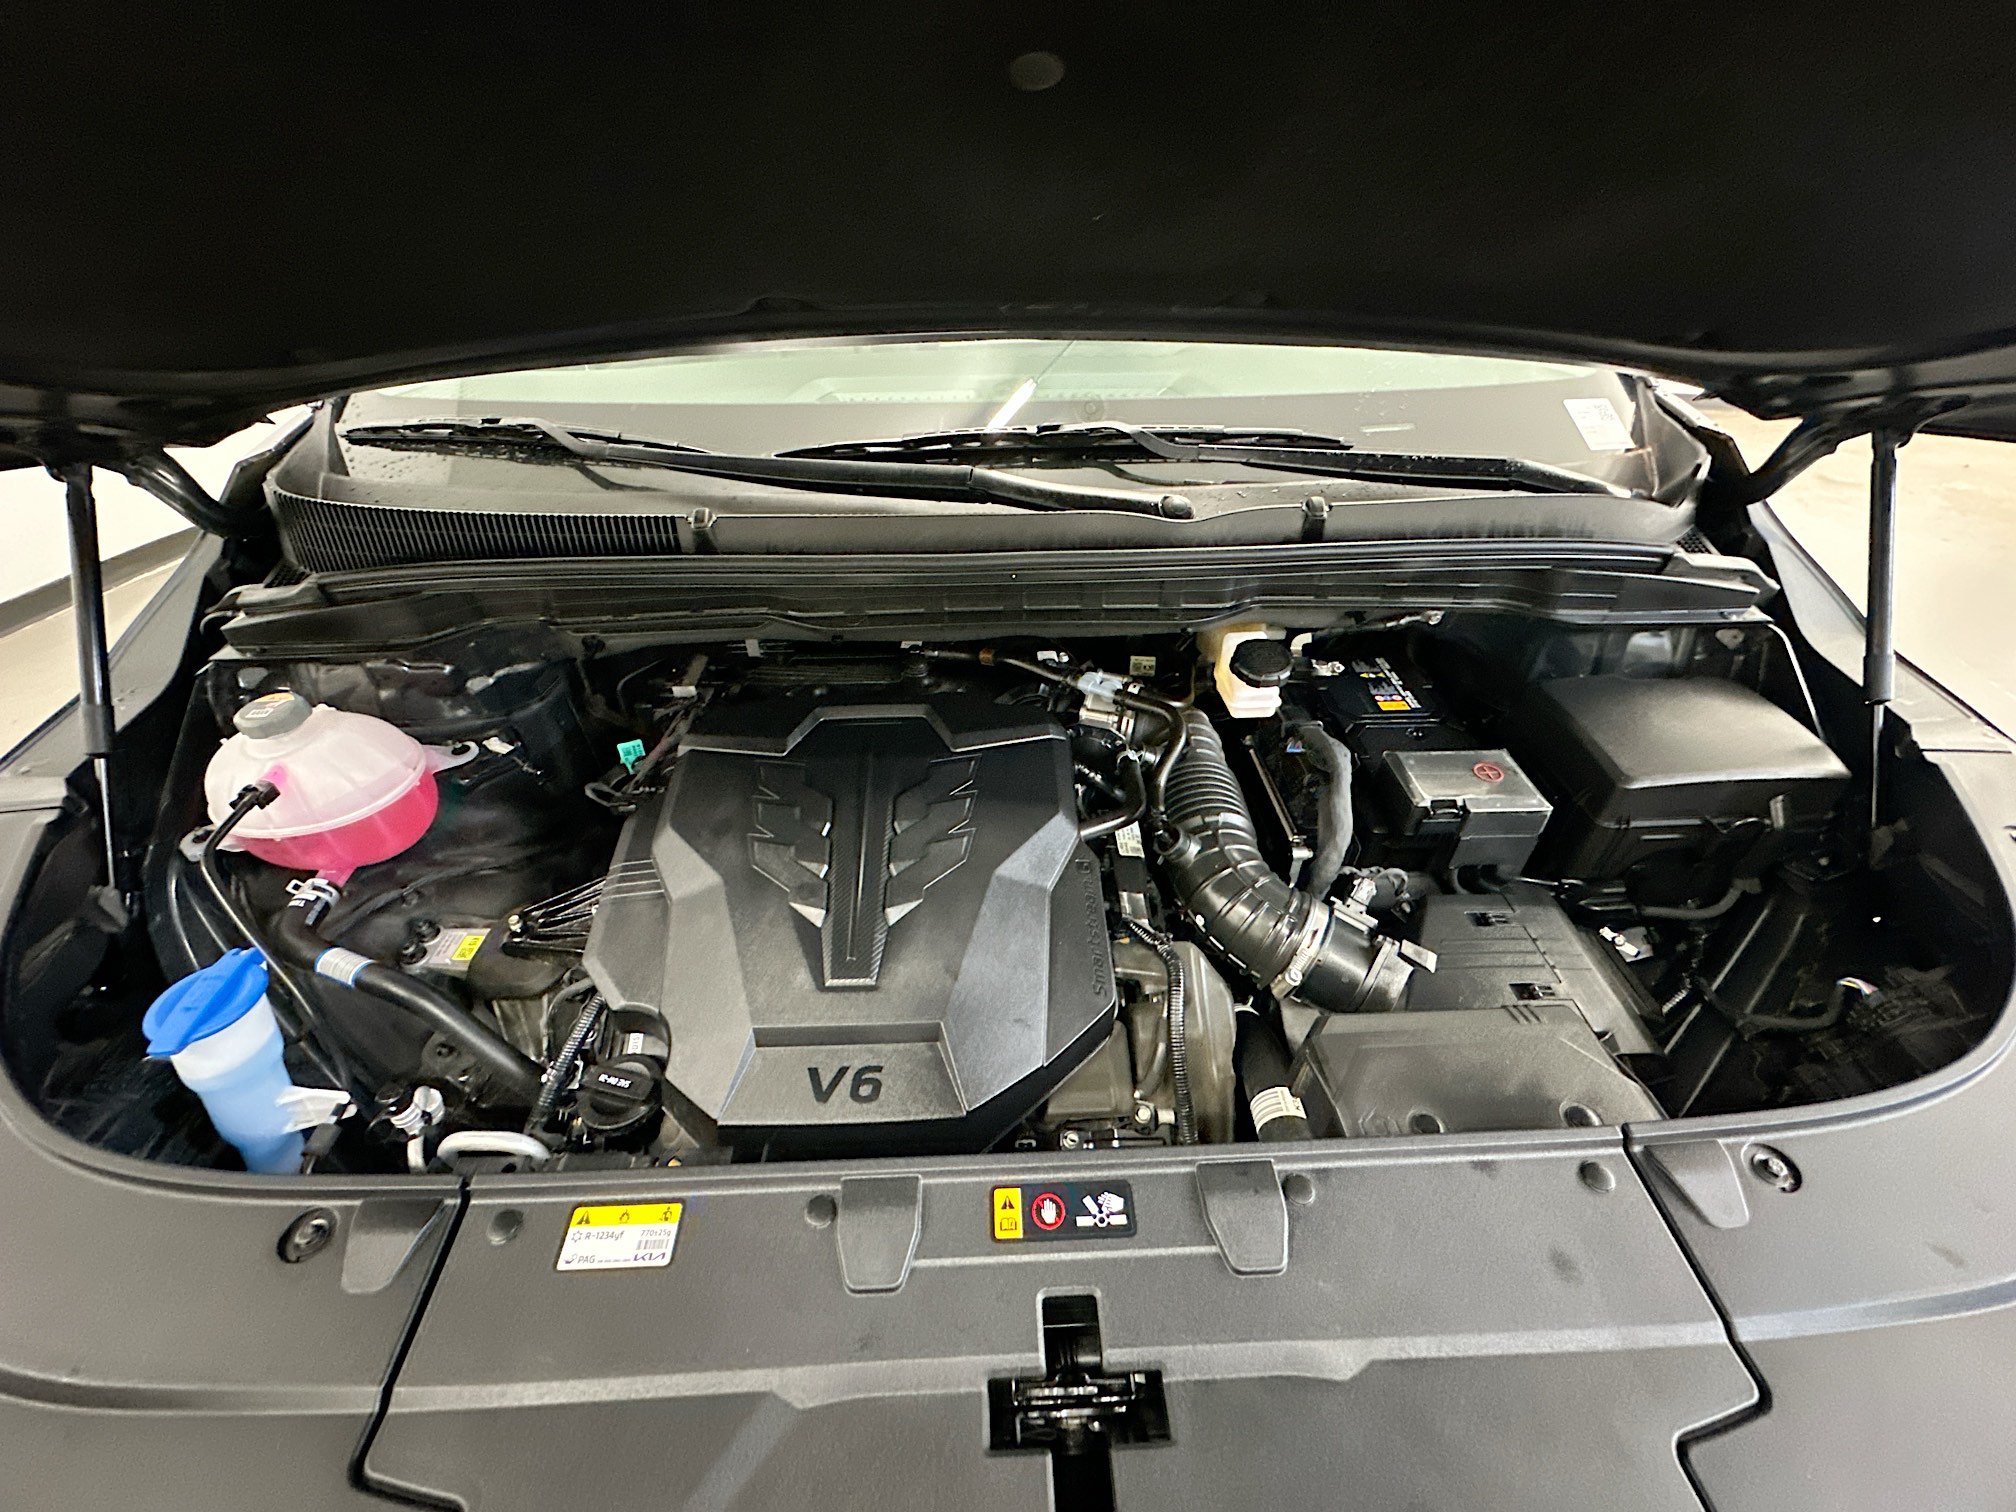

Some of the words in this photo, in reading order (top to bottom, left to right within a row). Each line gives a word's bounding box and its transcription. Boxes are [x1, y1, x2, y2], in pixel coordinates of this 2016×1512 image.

[1082, 878, 1107, 998] Smartstream
[807, 1065, 884, 1104] V6
[584, 1230, 625, 1241] R-1234yf
[577, 1254, 596, 1264] PAG
[633, 1252, 666, 1262] KIA
